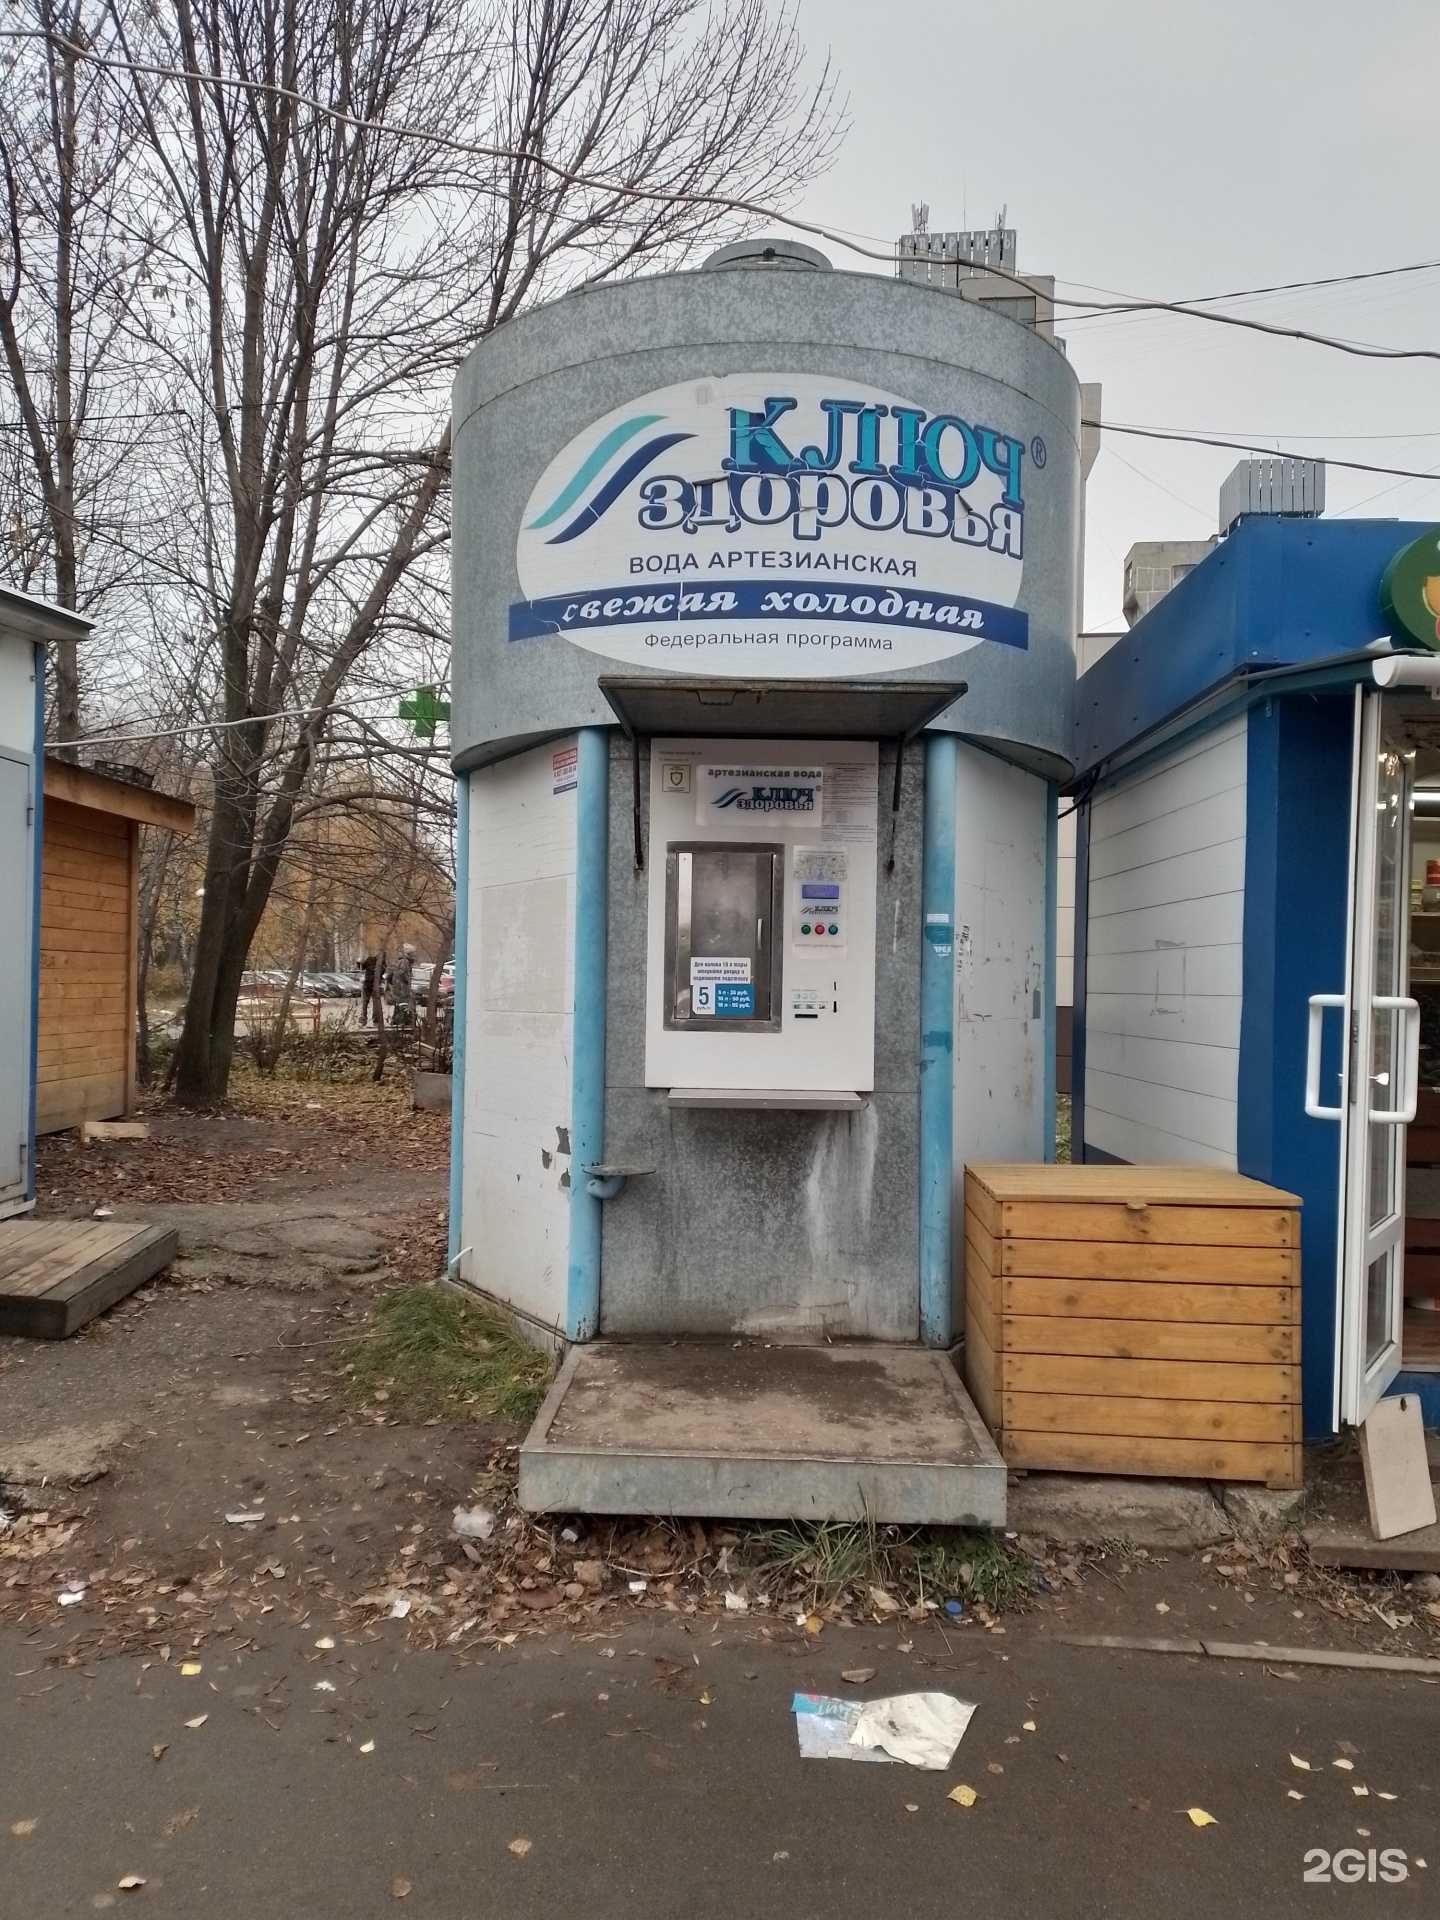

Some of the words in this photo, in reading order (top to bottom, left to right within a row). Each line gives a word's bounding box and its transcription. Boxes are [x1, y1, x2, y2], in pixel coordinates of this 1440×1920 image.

[629, 553, 699, 575] ВОДА
[708, 551, 917, 577] АРТЕЗИАНСКАЯ
[561, 591, 739, 622] свежая
[760, 589, 985, 629] холодная
[645, 632, 779, 648] Федеральная
[786, 632, 893, 650] программа
[707, 768, 790, 779] артезианская
[793, 769, 822, 779] вода
[699, 986, 709, 1005] 5
